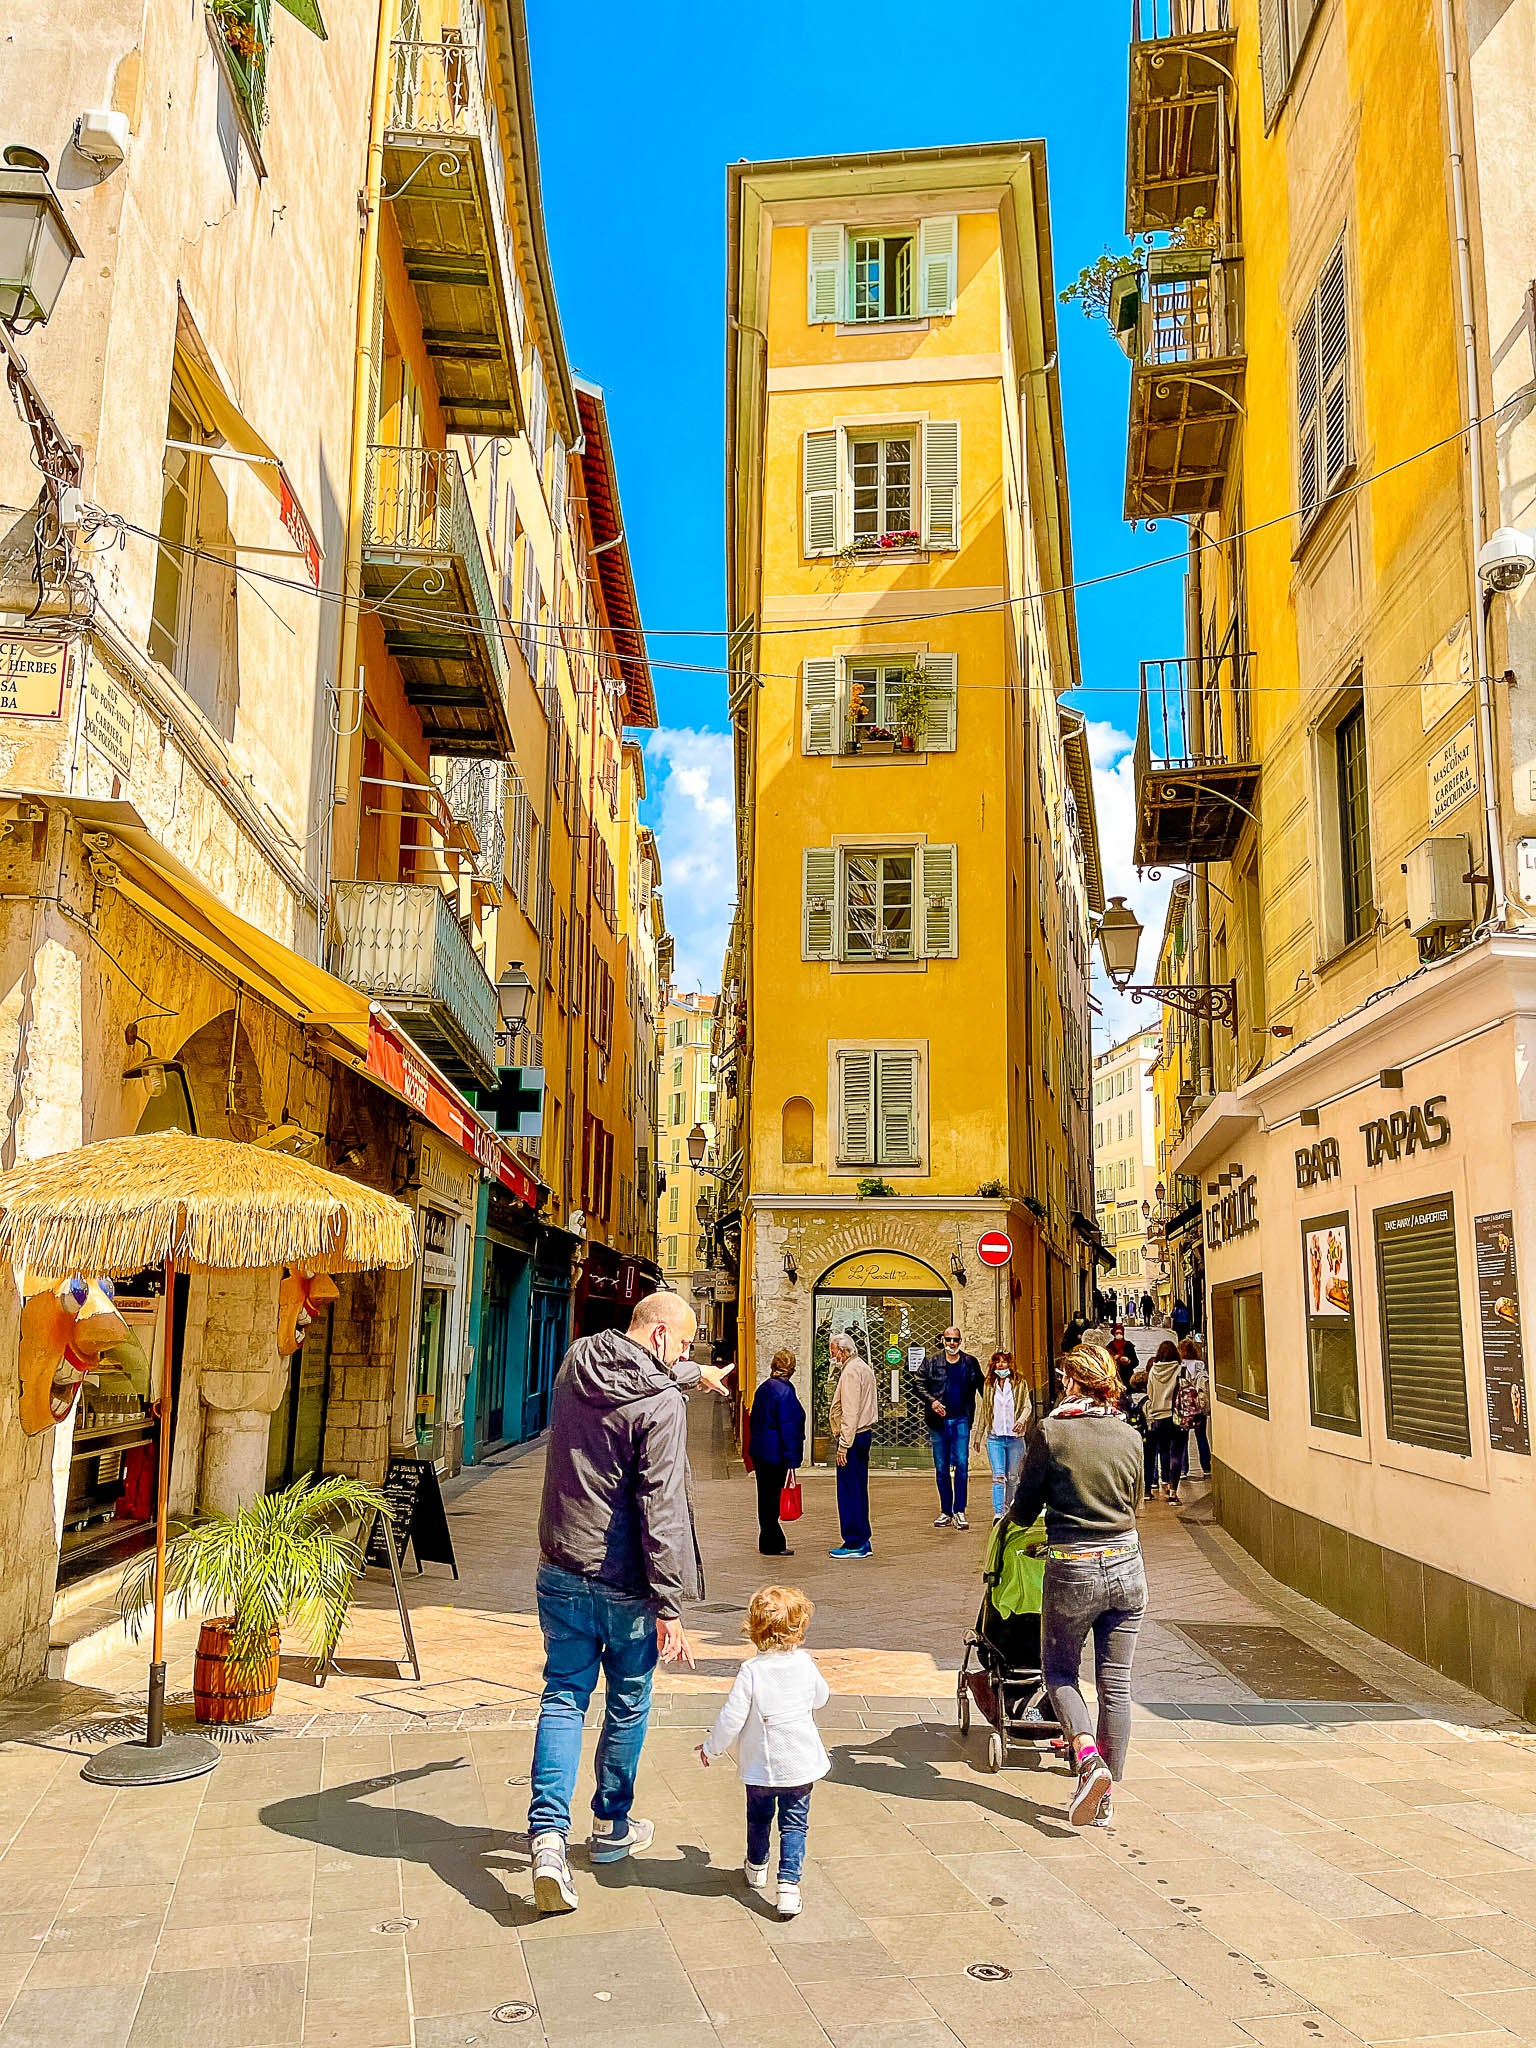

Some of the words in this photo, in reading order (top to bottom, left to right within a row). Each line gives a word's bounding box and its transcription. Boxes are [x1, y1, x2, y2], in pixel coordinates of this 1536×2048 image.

[9, 659, 57, 674] HERBES
[90, 683, 99, 699] DU
[107, 685, 118, 704] RUE
[95, 711, 122, 747] CARRIERA
[1444, 742, 1457, 761] RUE
[1435, 766, 1470, 802] CARRIERA
[1295, 1137, 1341, 1188] BAR
[1359, 1095, 1451, 1167] TAPAS
